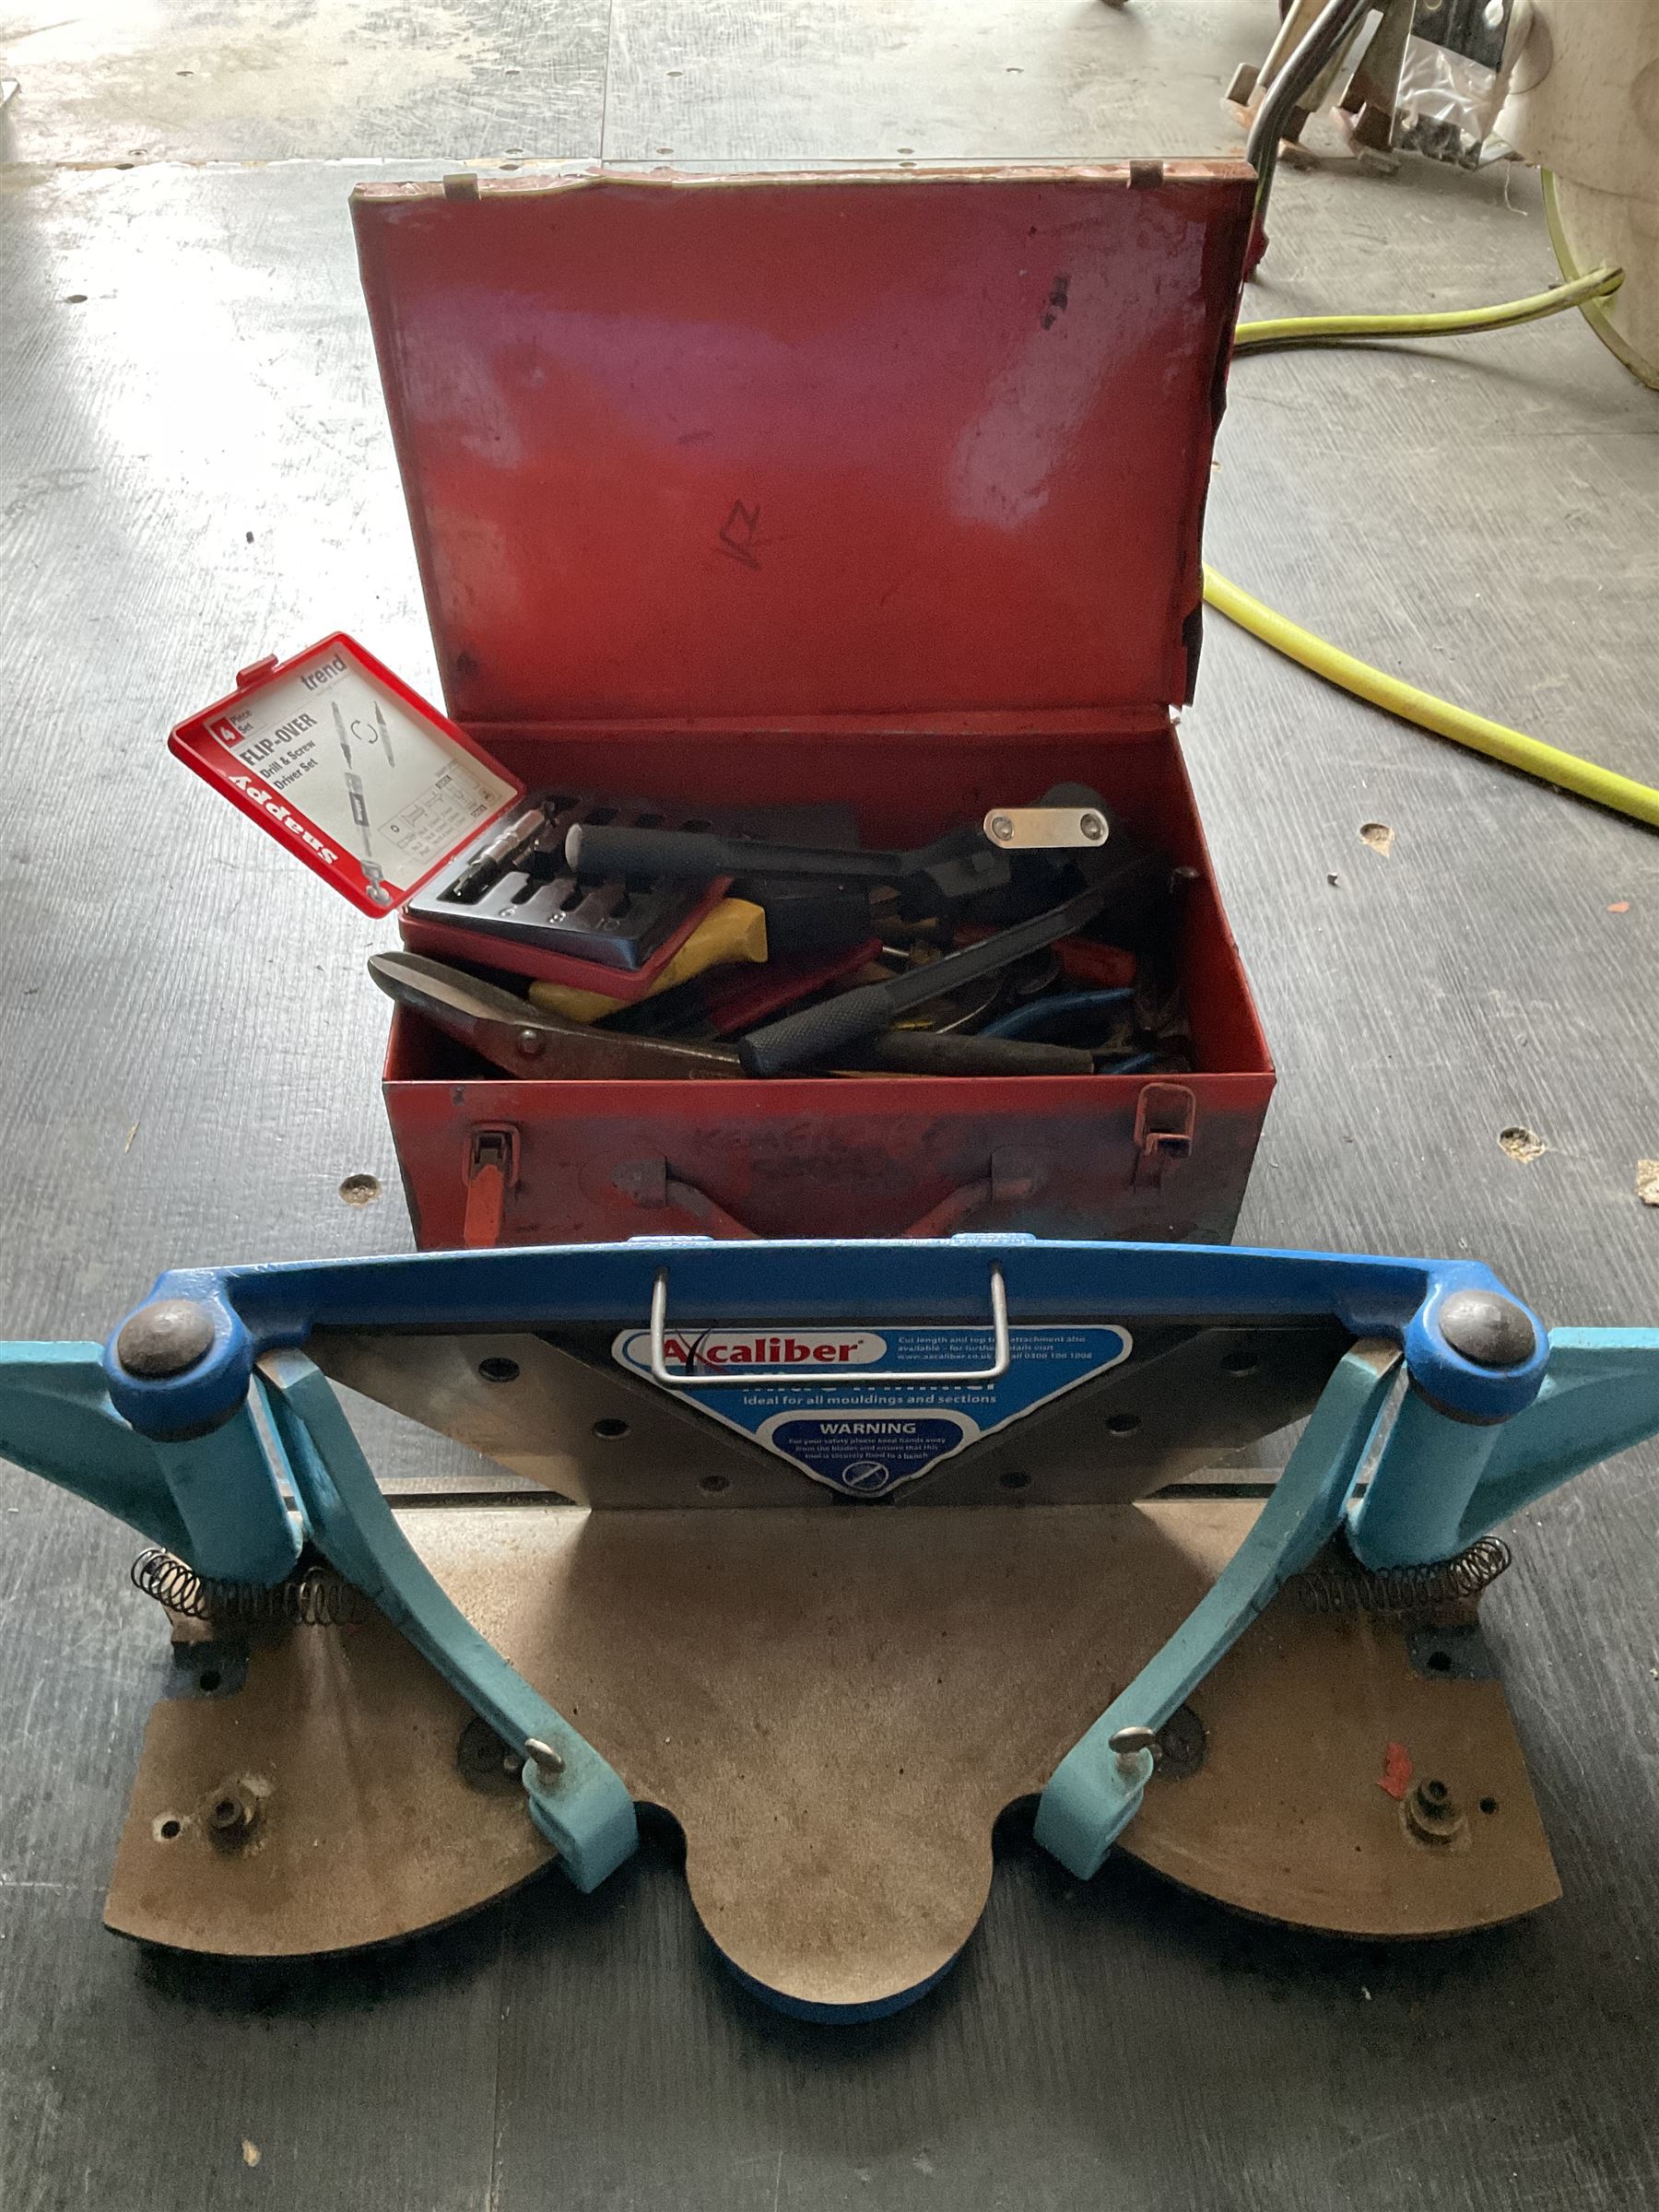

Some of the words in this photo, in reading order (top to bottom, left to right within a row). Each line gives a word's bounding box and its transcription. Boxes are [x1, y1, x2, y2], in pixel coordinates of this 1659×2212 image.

[301, 654, 347, 691] trend
[230, 710, 253, 726] Piece
[220, 726, 236, 741] 4
[238, 721, 254, 735] Set
[239, 712, 318, 767] FLIP-OVER
[259, 759, 283, 779] Drill
[279, 756, 290, 767] &
[287, 740, 316, 760] Screw
[274, 769, 303, 791] Driver
[301, 758, 319, 772] Set
[228, 775, 339, 865] Snappy
[915, 1336, 947, 1345] length
[744, 1396, 779, 1406] Ideal
[782, 1395, 803, 1405] for
[806, 1395, 824, 1405] all
[828, 1395, 904, 1406] mouldings
[907, 1395, 935, 1405] and
[938, 1394, 997, 1405] sections
[820, 1422, 916, 1435] WARNING
